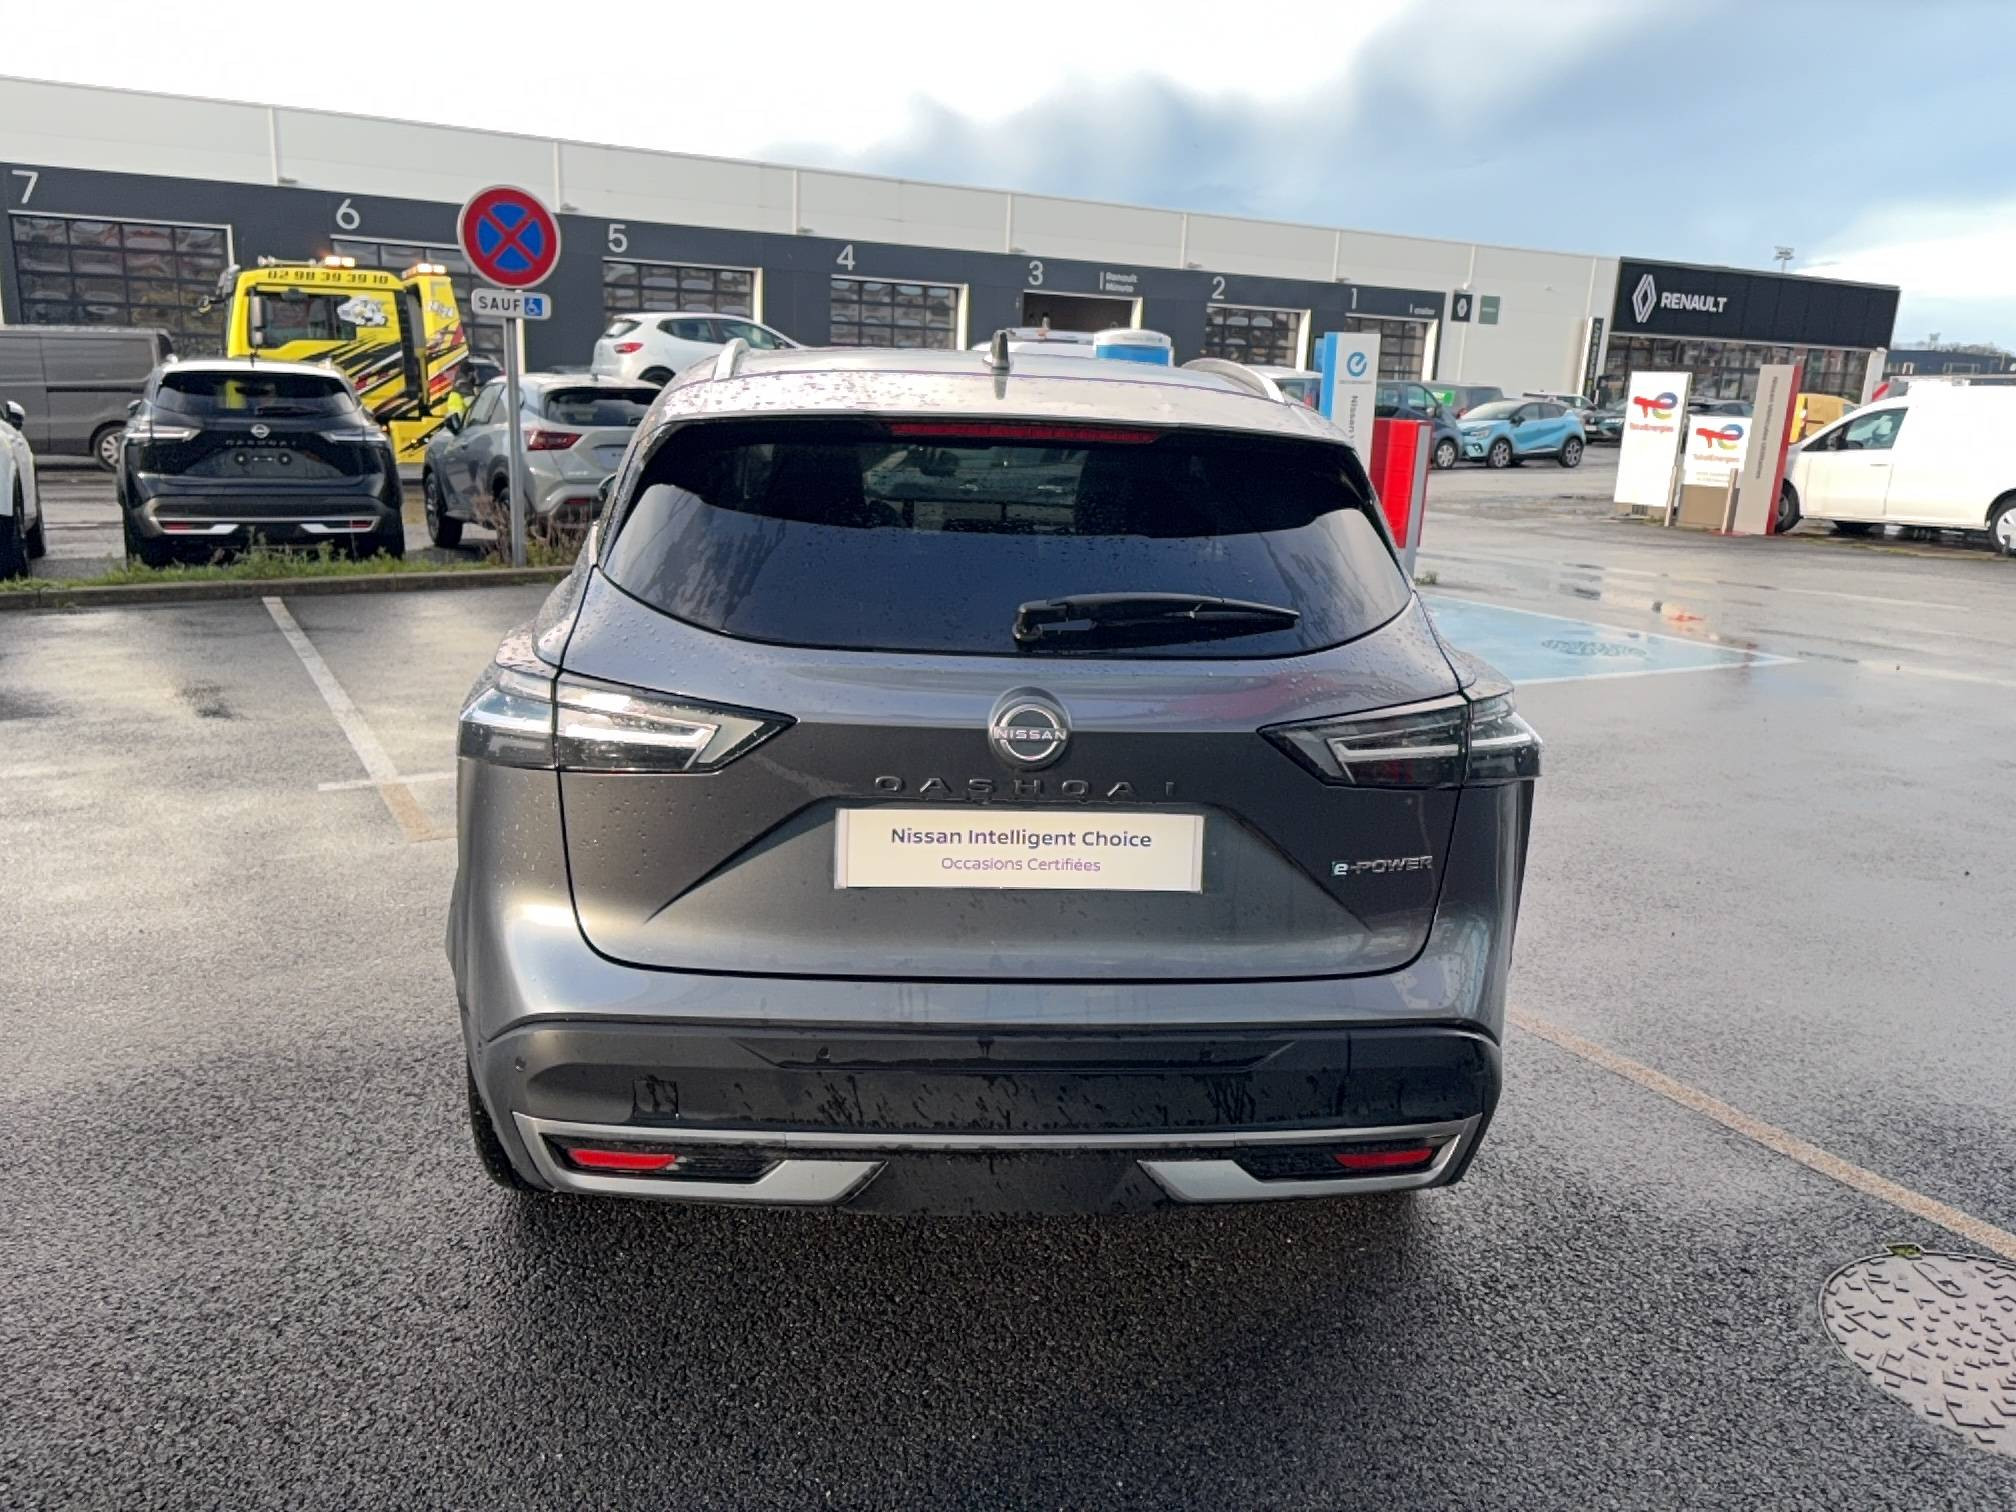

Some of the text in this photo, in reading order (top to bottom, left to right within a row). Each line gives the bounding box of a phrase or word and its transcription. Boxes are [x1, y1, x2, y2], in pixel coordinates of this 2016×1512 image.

[12, 169, 39, 204] 7
[335, 199, 361, 230] 6
[607, 223, 628, 253] 5
[836, 244, 856, 271] 4
[268, 270, 289, 279] 02
[1028, 260, 1044, 286] 3
[1211, 276, 1226, 300] 2
[478, 296, 521, 312] SAUF
[1351, 288, 1358, 310] 1
[1660, 292, 1728, 313] RENAULT
[994, 729, 1067, 741] NISSAN
[874, 776, 1176, 797] QASHQAI
[891, 828, 1152, 849] Nissan Intelligent Choice
[941, 857, 1101, 872] Occasions Certifiées
[1331, 856, 1433, 876] e-POWER
